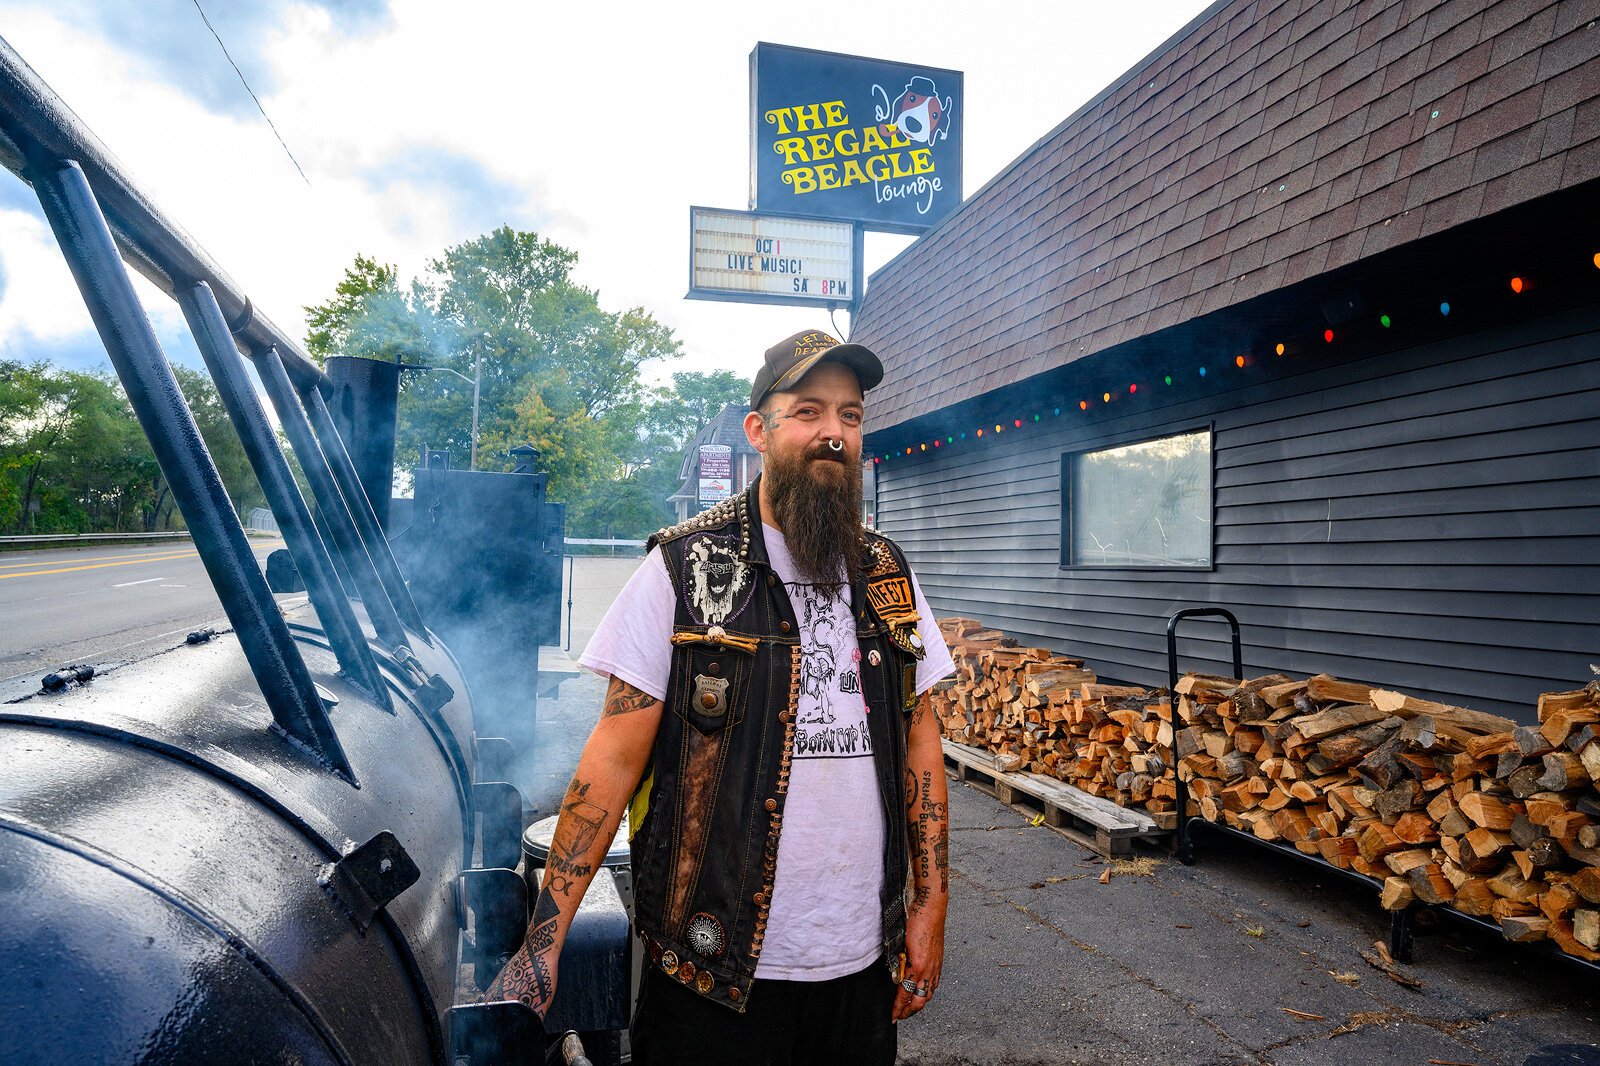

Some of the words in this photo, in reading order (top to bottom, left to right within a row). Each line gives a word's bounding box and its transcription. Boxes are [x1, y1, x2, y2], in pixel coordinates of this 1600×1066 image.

[764, 100, 849, 135] THE
[773, 123, 912, 165] REGAL
[781, 148, 935, 195] BEAGLE
[755, 238, 773, 254] OCT
[776, 239, 781, 255] 1
[727, 254, 754, 271] LIVE
[761, 257, 802, 275] MUSIC!
[795, 333, 818, 347] LET
[867, 580, 907, 608] INFEST
[921, 771, 932, 811] SPRING
[919, 849, 929, 879] 2020
